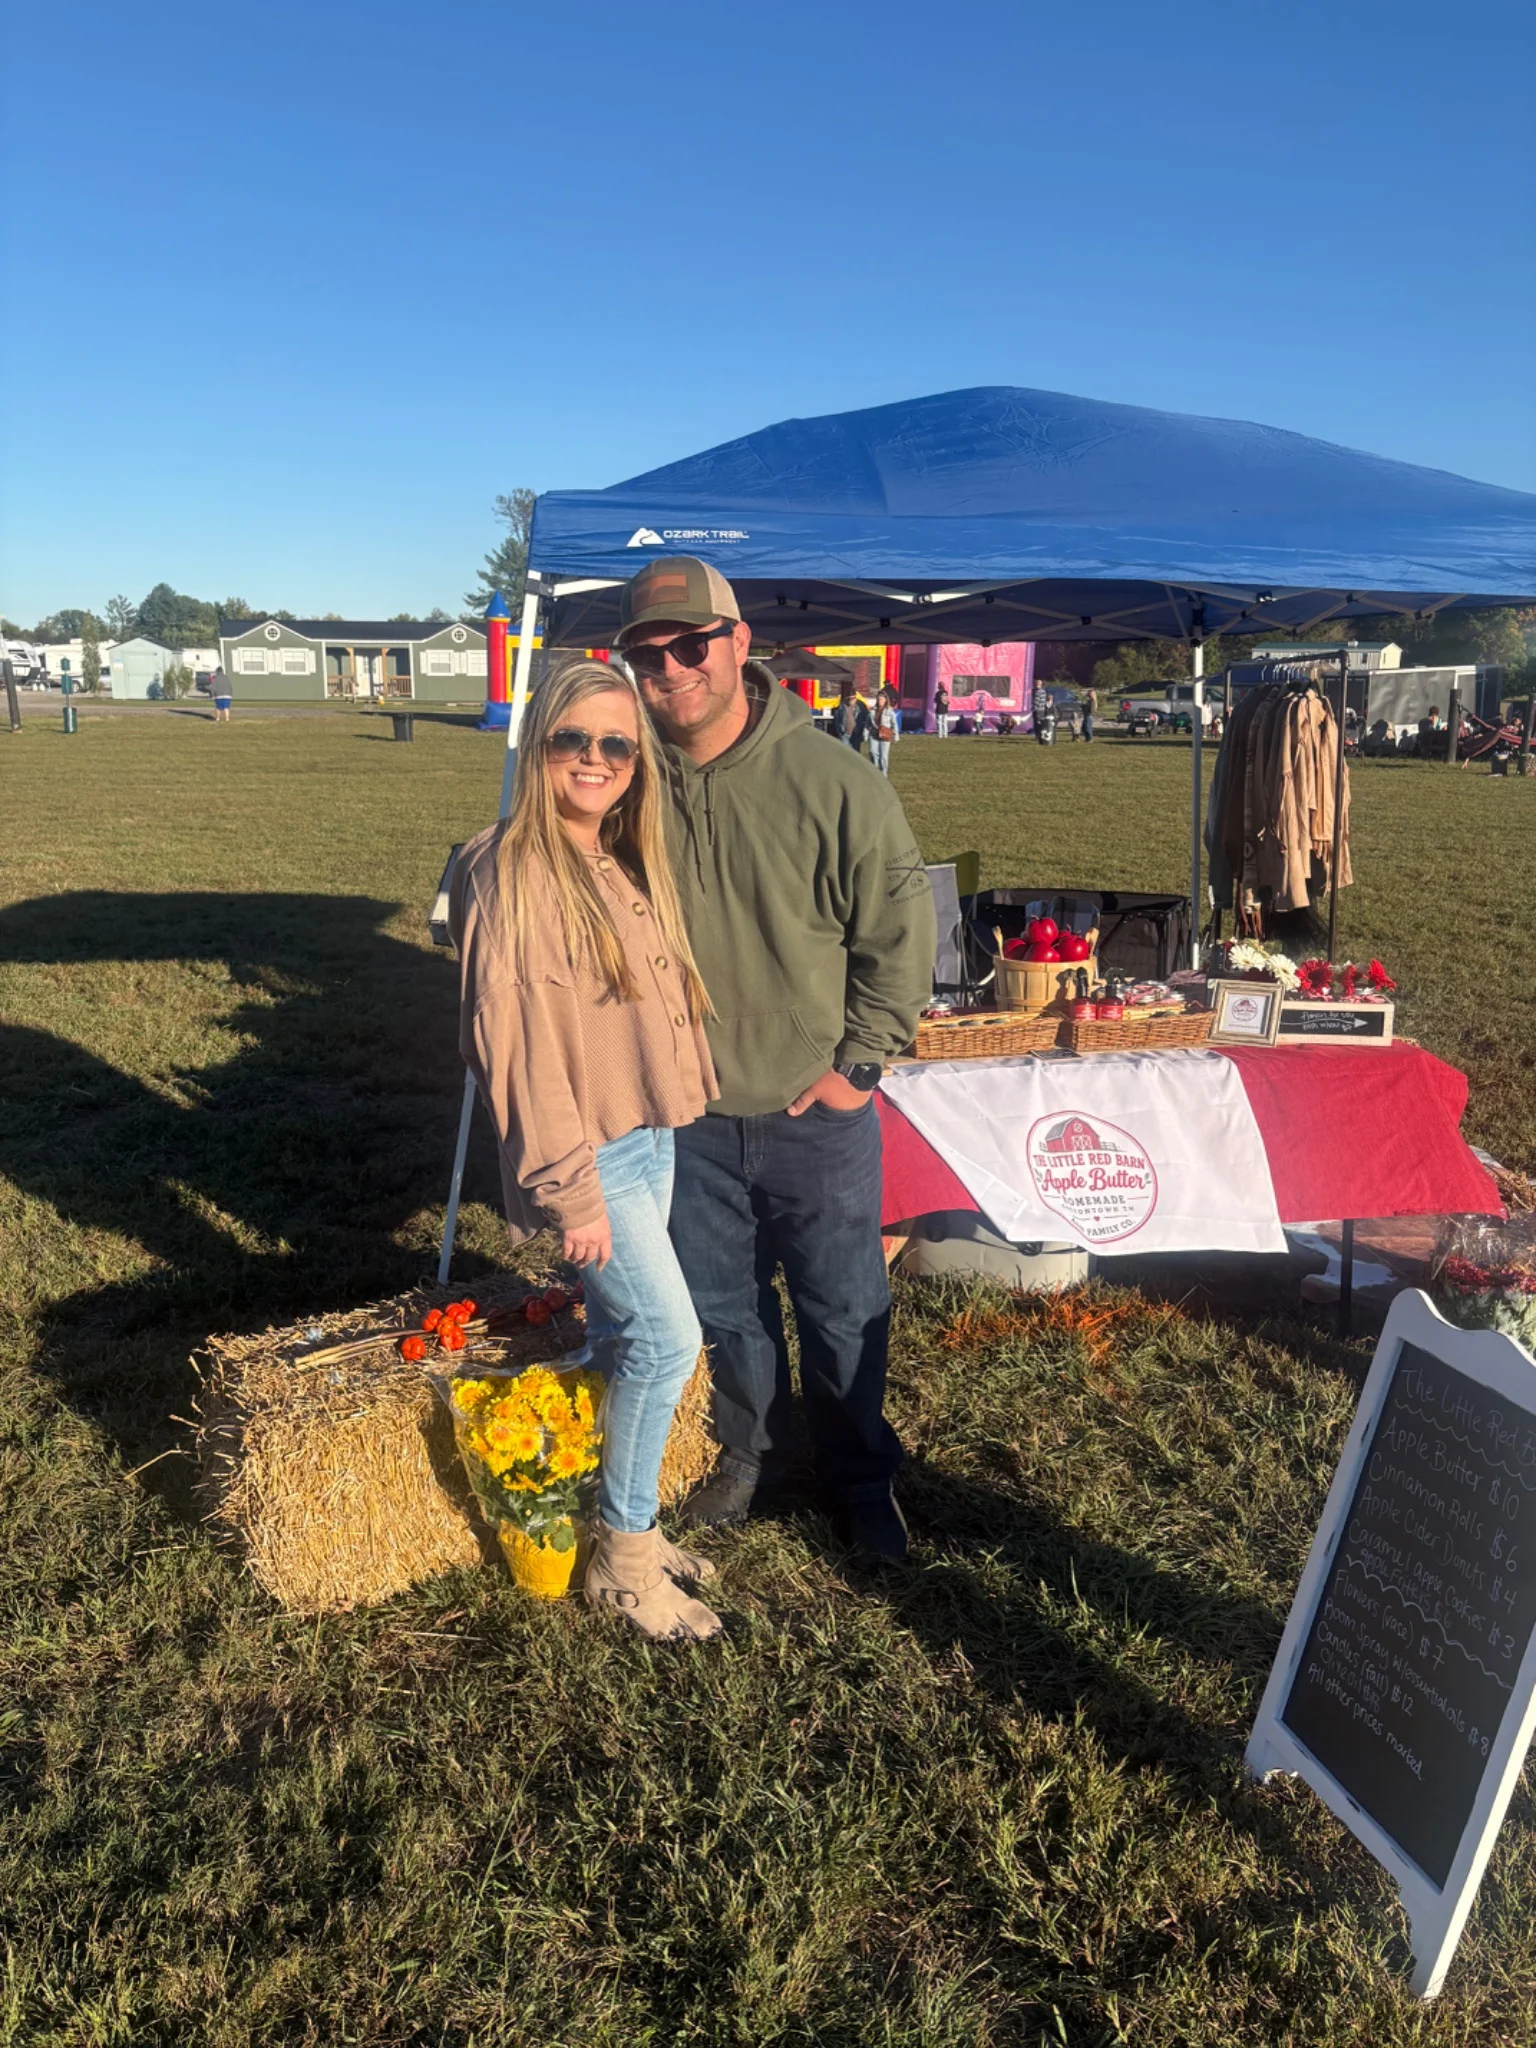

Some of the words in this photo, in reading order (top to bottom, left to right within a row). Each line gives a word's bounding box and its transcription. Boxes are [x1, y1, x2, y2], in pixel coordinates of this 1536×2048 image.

[663, 530, 709, 539] OZARK
[710, 530, 750, 539] TRAIL
[1033, 1154, 1047, 1168] THE
[1047, 1153, 1085, 1168] LITTLE
[1088, 1153, 1112, 1165] RED
[1116, 1154, 1145, 1169] BARN
[1041, 1168, 1087, 1195] Apple
[1088, 1167, 1145, 1191] Butter
[1086, 1223, 1120, 1236] FAMILY
[1401, 1368, 1435, 1402] The
[1440, 1384, 1481, 1433] Little
[1487, 1410, 1519, 1450] Red
[1381, 1416, 1428, 1459] Apple
[1429, 1440, 1484, 1492] Butter
[1369, 1452, 1446, 1517] Cinnamon
[1449, 1499, 1483, 1540] Rolls
[1349, 1518, 1412, 1572] Caramel
[1445, 1585, 1486, 1632] Cookies
[1358, 1485, 1400, 1524] Apple
[1404, 1508, 1441, 1549] Cider
[1437, 1532, 1486, 1591] Donuts
[1324, 1601, 1356, 1631] Room
[1357, 1624, 1389, 1670] Spray
[1333, 1569, 1380, 1618] Flowers
[1381, 1605, 1415, 1648] (vase)
[1308, 1662, 1326, 1686] All
[1324, 1678, 1355, 1708] other
[1352, 1702, 1384, 1736] prices
[1360, 1659, 1390, 1697] (fall)
